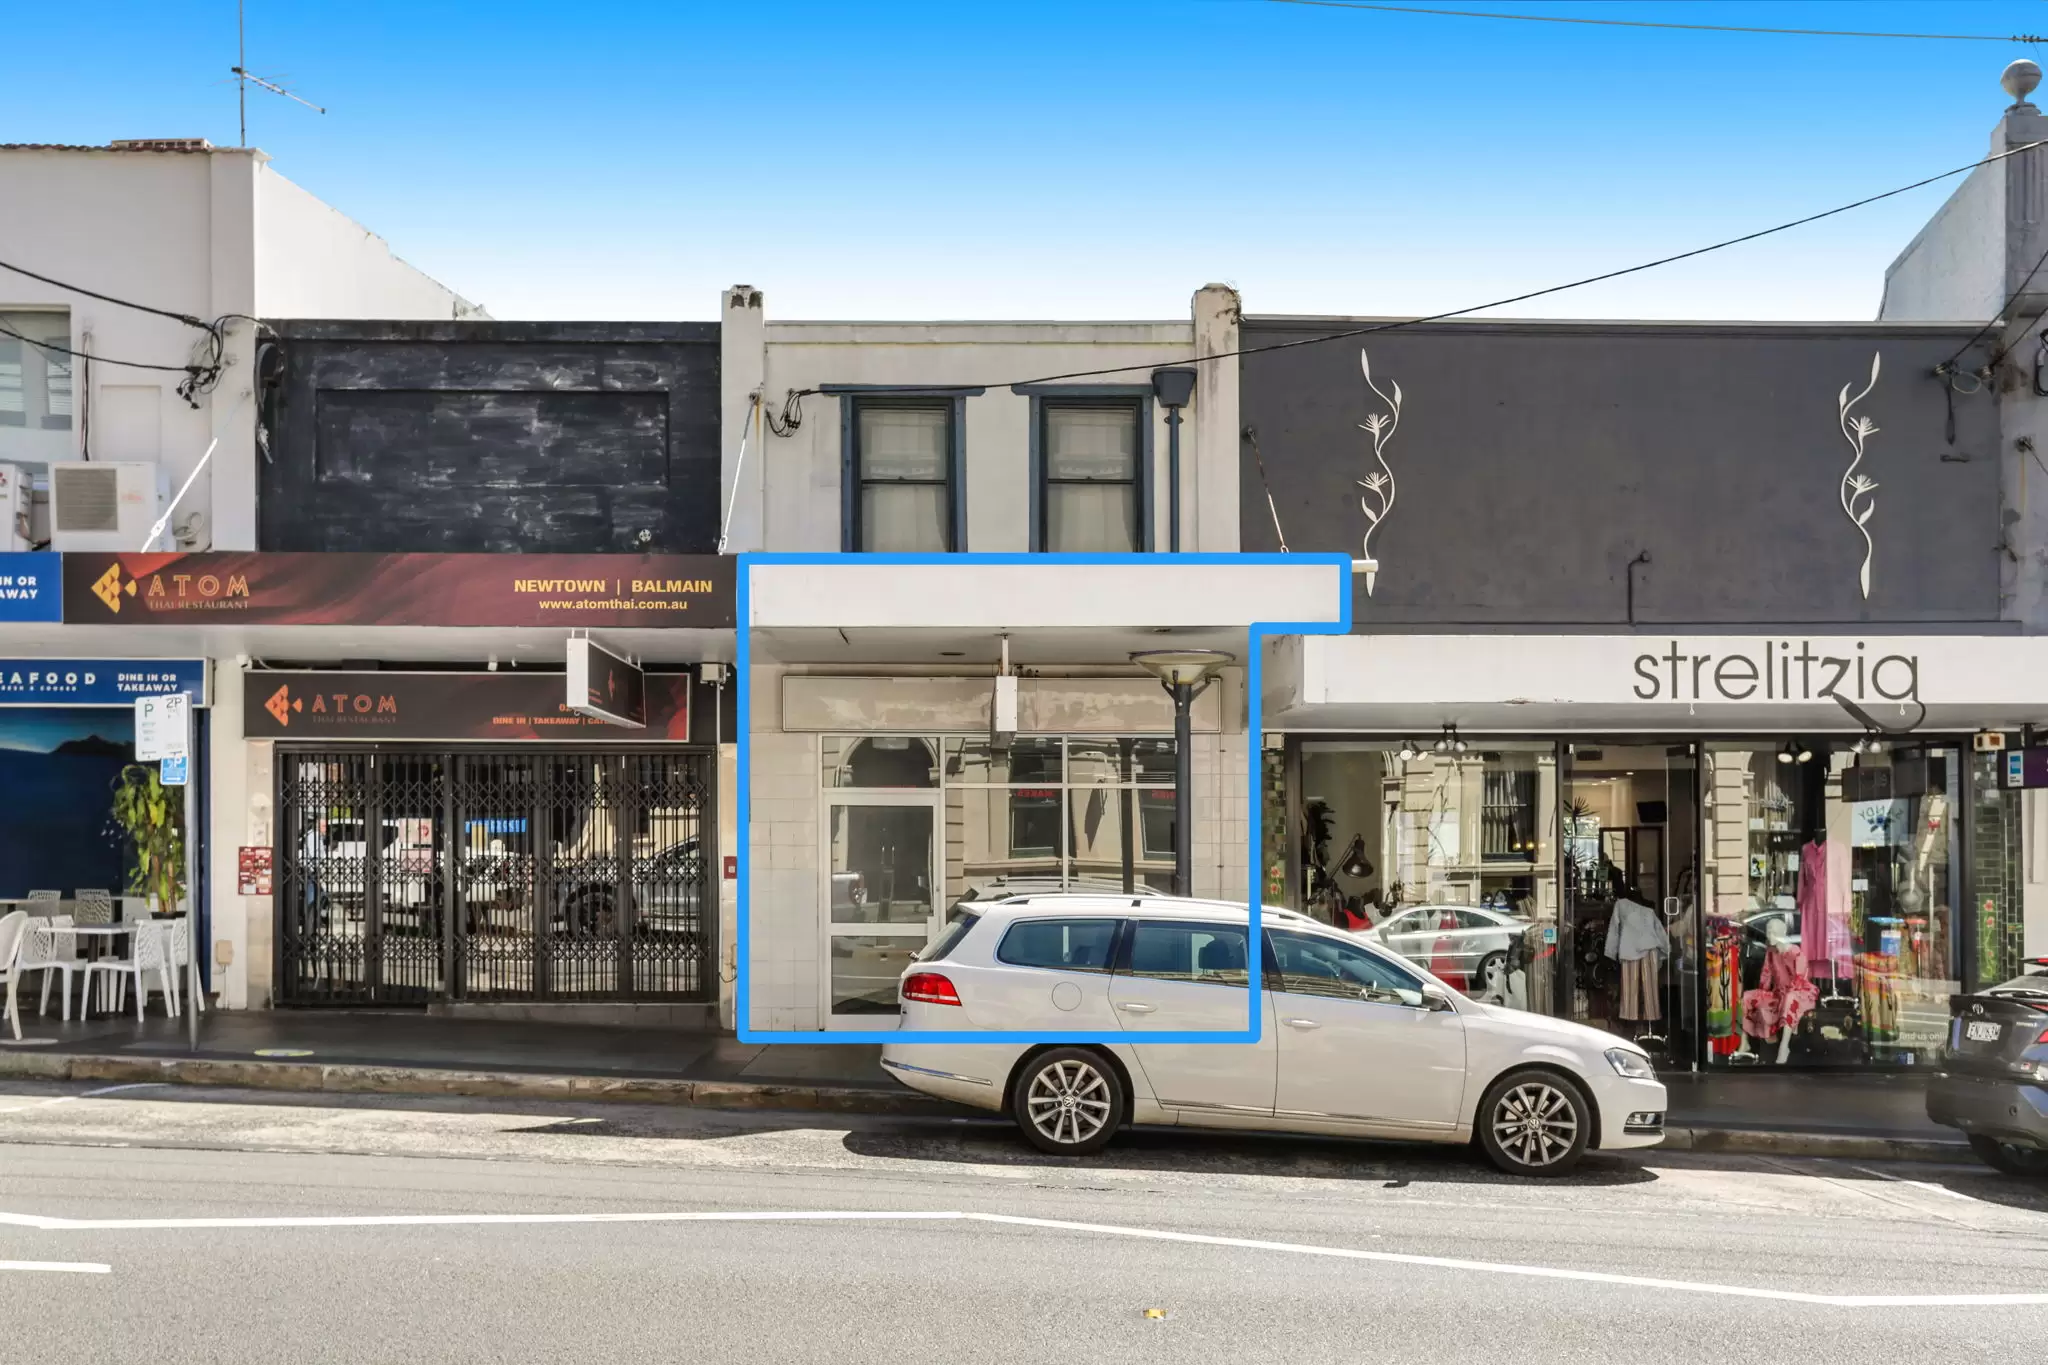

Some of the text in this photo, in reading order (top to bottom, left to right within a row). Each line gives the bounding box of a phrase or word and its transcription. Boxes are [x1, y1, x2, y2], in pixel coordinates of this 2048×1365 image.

[17, 576, 37, 586] OR
[148, 574, 249, 597] ATOM
[514, 579, 713, 593] NEWTOWN BALMAIN
[178, 600, 248, 609] RESTAURANT
[539, 599, 687, 610] www.atomthai.com.au
[118, 673, 177, 682] DINE IN OR
[117, 683, 178, 692] TAKEAWAY
[1633, 640, 1926, 734] strelitzia
[166, 697, 183, 709] 2P
[312, 694, 397, 713] ATOM
[144, 703, 154, 718] P
[492, 717, 514, 725] DINE
[516, 717, 526, 725] IN
[534, 717, 580, 725] TAKEAWAY
[1900, 1031, 1948, 1041] find us onli
